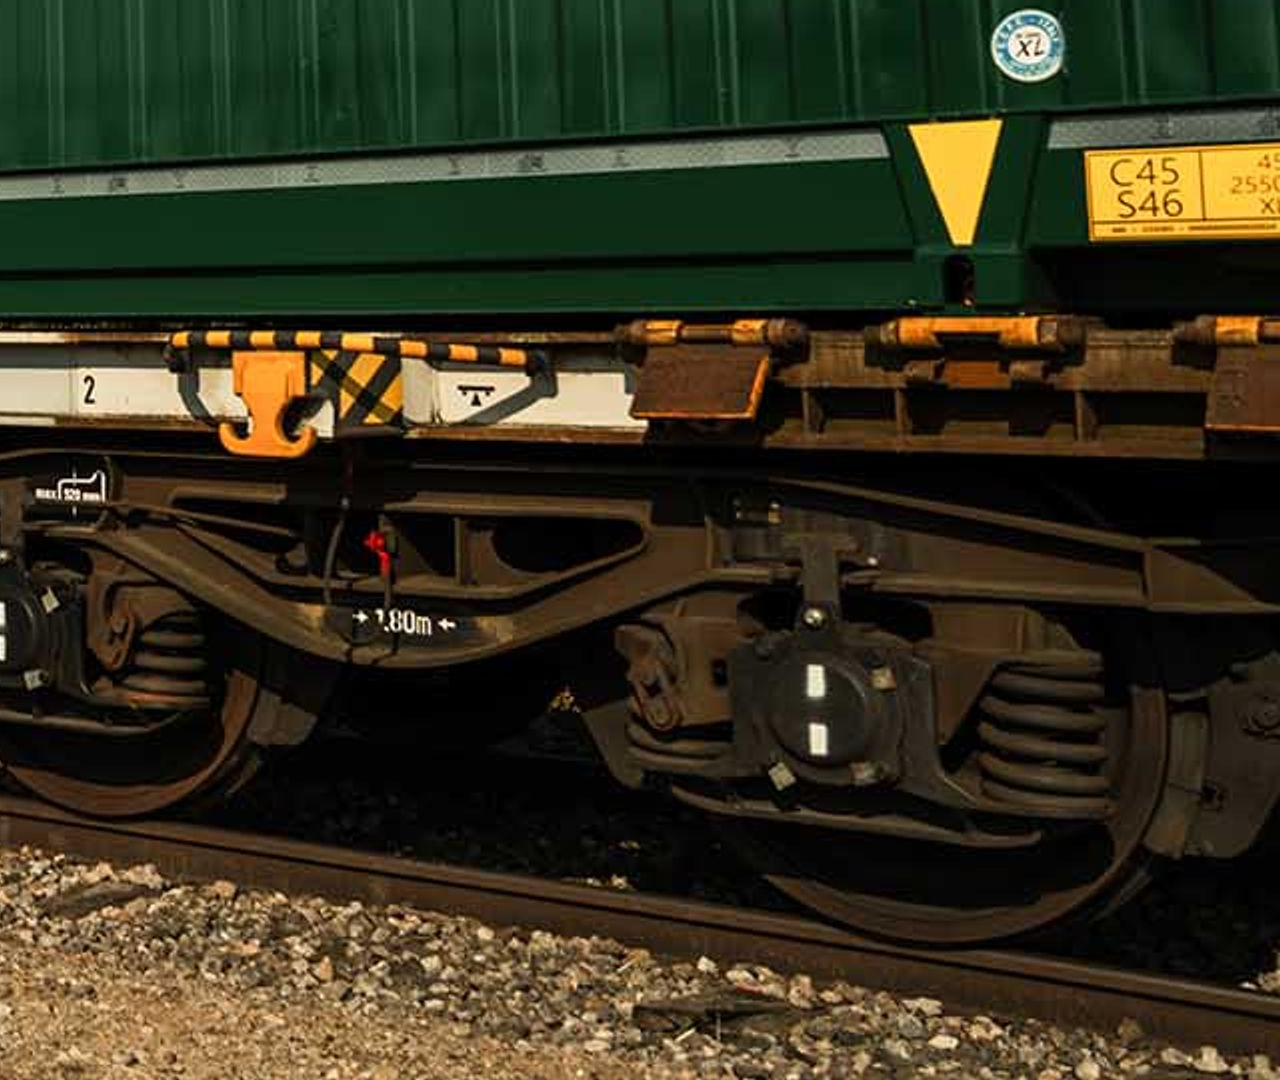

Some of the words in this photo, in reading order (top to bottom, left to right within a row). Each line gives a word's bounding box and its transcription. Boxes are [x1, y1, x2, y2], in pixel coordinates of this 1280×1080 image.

[1109, 157, 1179, 187] C45
[1117, 189, 1184, 219] S46
[84, 376, 95, 404] 2
